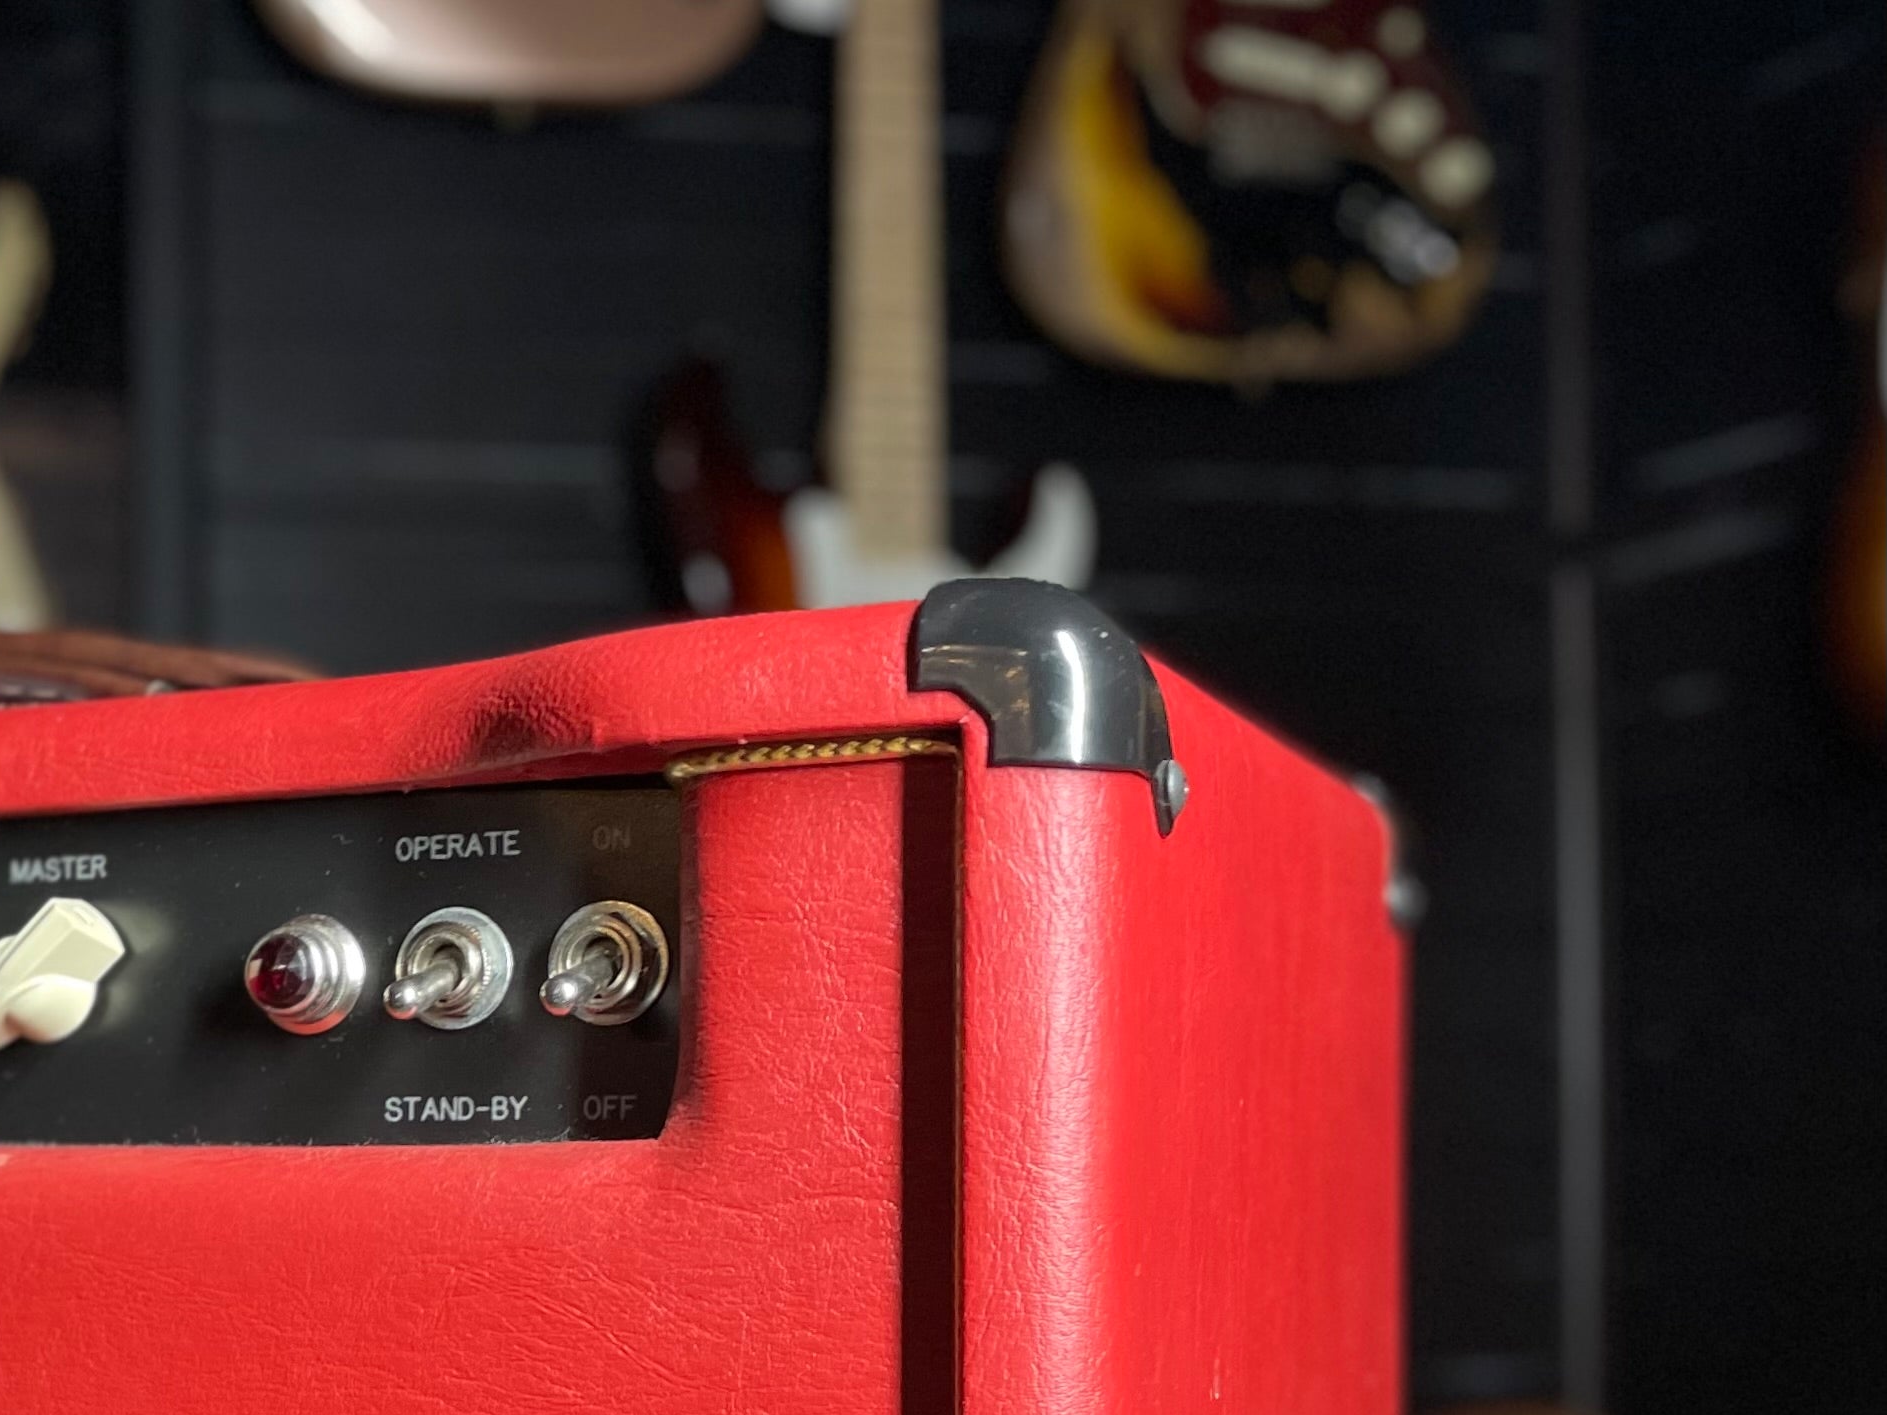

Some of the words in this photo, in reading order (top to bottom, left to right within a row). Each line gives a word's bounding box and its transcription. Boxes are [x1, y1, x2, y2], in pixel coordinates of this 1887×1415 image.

[395, 829, 521, 861] OPERATE
[593, 825, 632, 851] ON
[9, 854, 108, 885] MASTER
[383, 1095, 528, 1122] STAND-BY
[583, 1095, 637, 1120] OFF
